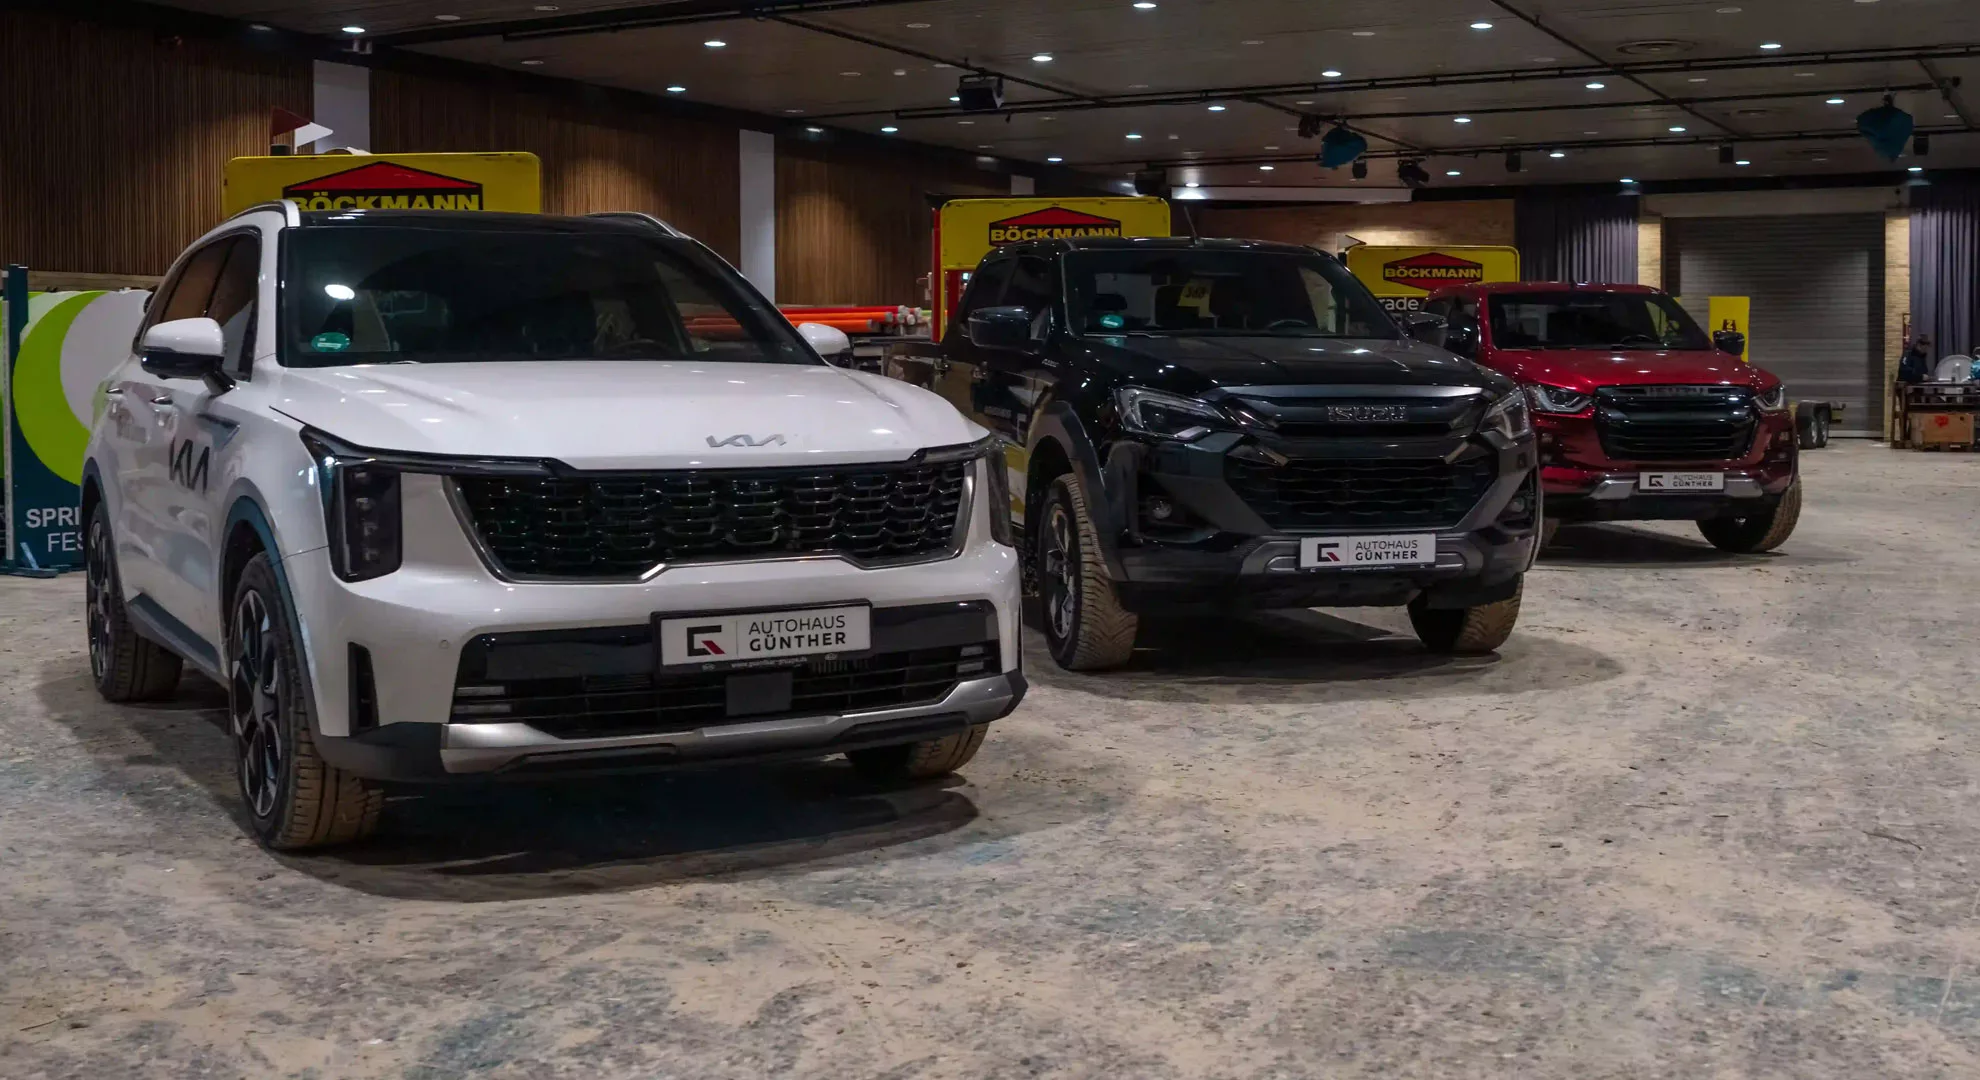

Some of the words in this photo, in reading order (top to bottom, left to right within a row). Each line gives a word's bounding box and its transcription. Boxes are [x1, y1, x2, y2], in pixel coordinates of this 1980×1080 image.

[991, 225, 1120, 242] BÖCKMANN
[1384, 265, 1481, 278] BÖCKMANN
[25, 506, 81, 528] SPRI
[1355, 540, 1418, 551] AUTOHAUS
[1355, 550, 1418, 561] GÜNTHER
[748, 615, 846, 636] AUTOHAUS
[749, 632, 846, 652] GÜNTHER
